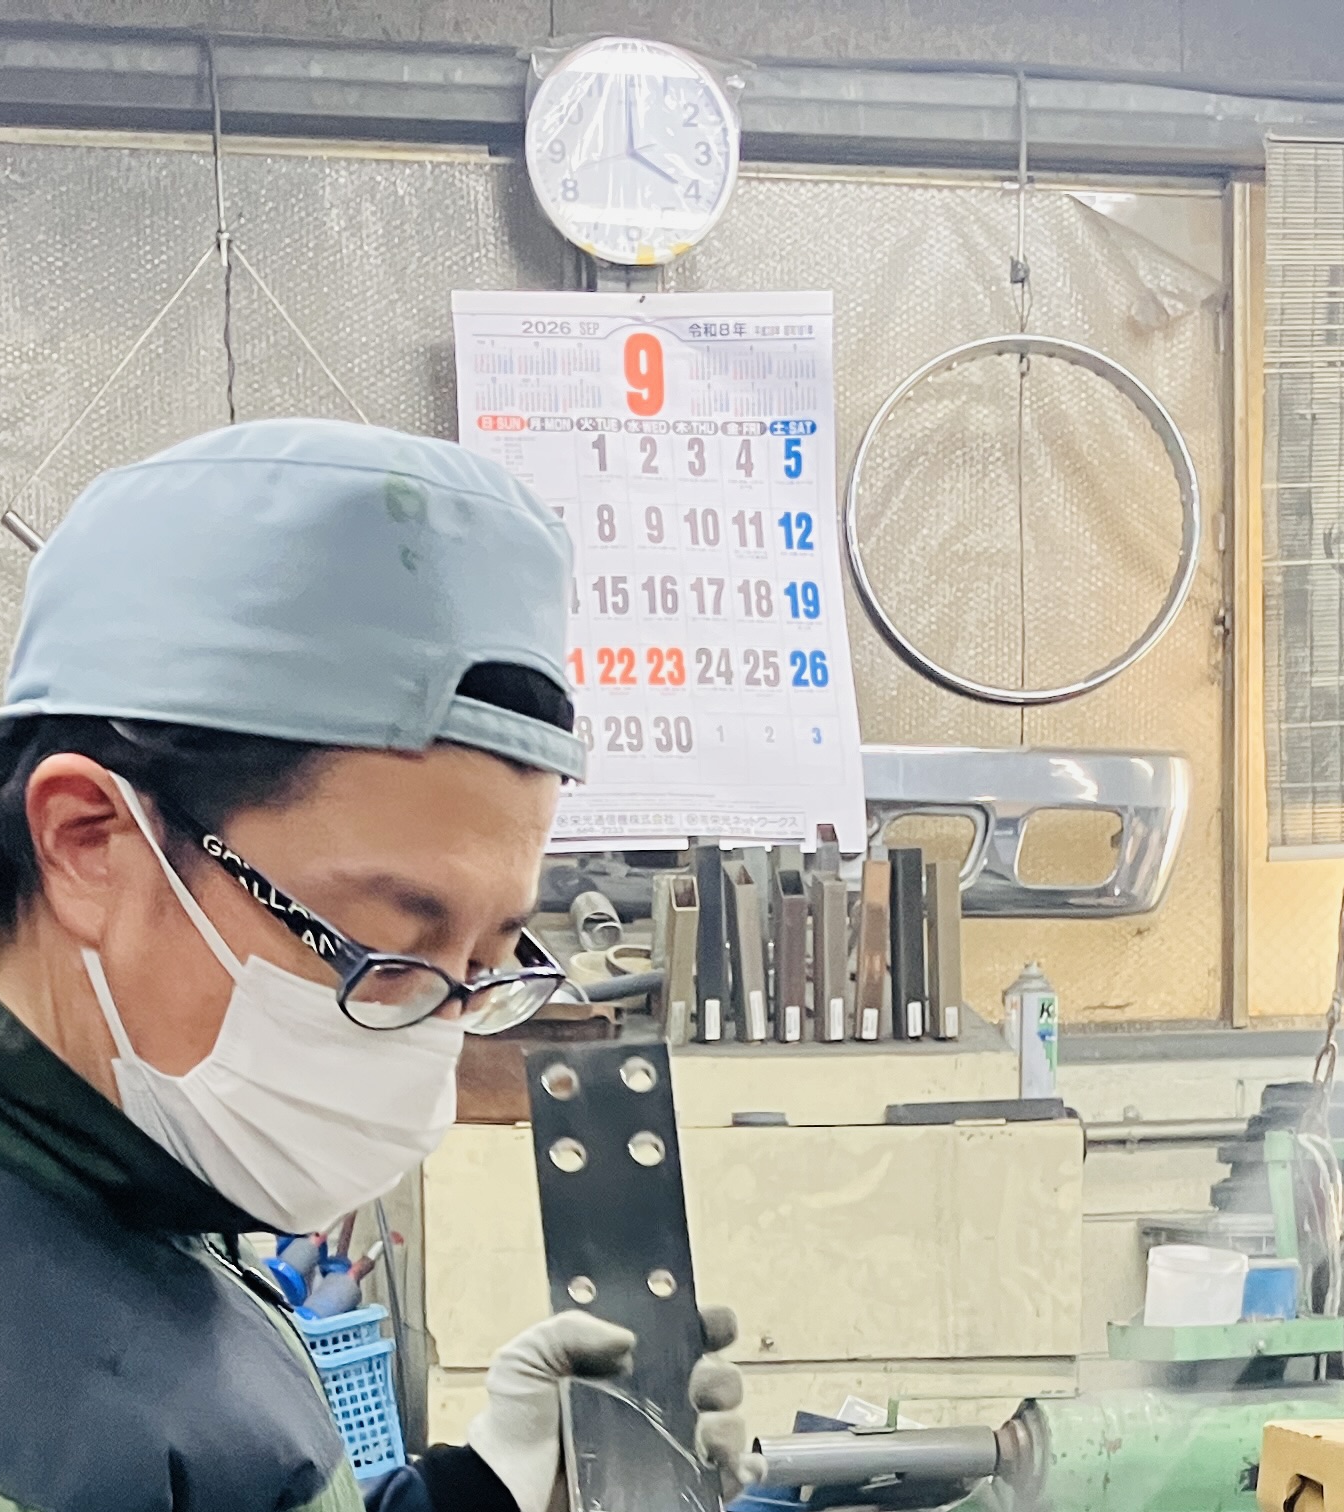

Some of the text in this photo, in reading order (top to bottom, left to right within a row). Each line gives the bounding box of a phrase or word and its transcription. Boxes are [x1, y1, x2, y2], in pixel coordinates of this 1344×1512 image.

[682, 102, 700, 128] 2
[548, 139, 566, 164] 9
[694, 141, 712, 166] 3
[561, 178, 579, 202] 8
[683, 179, 702, 201] 4
[521, 320, 600, 336] 2026 SEP
[688, 323, 748, 338] 令和8年
[623, 331, 664, 417] 9
[592, 434, 803, 479] 1 2 3 4 5
[597, 504, 814, 551] 8 9 10 11 12
[592, 576, 821, 620] 15 16 17 18 19
[567, 647, 829, 688] 1 22 23 24 25 26
[604, 716, 644, 752] 29
[654, 716, 694, 753] 30
[716, 725, 725, 742] 1
[765, 726, 775, 743] 2
[812, 727, 822, 745] 3
